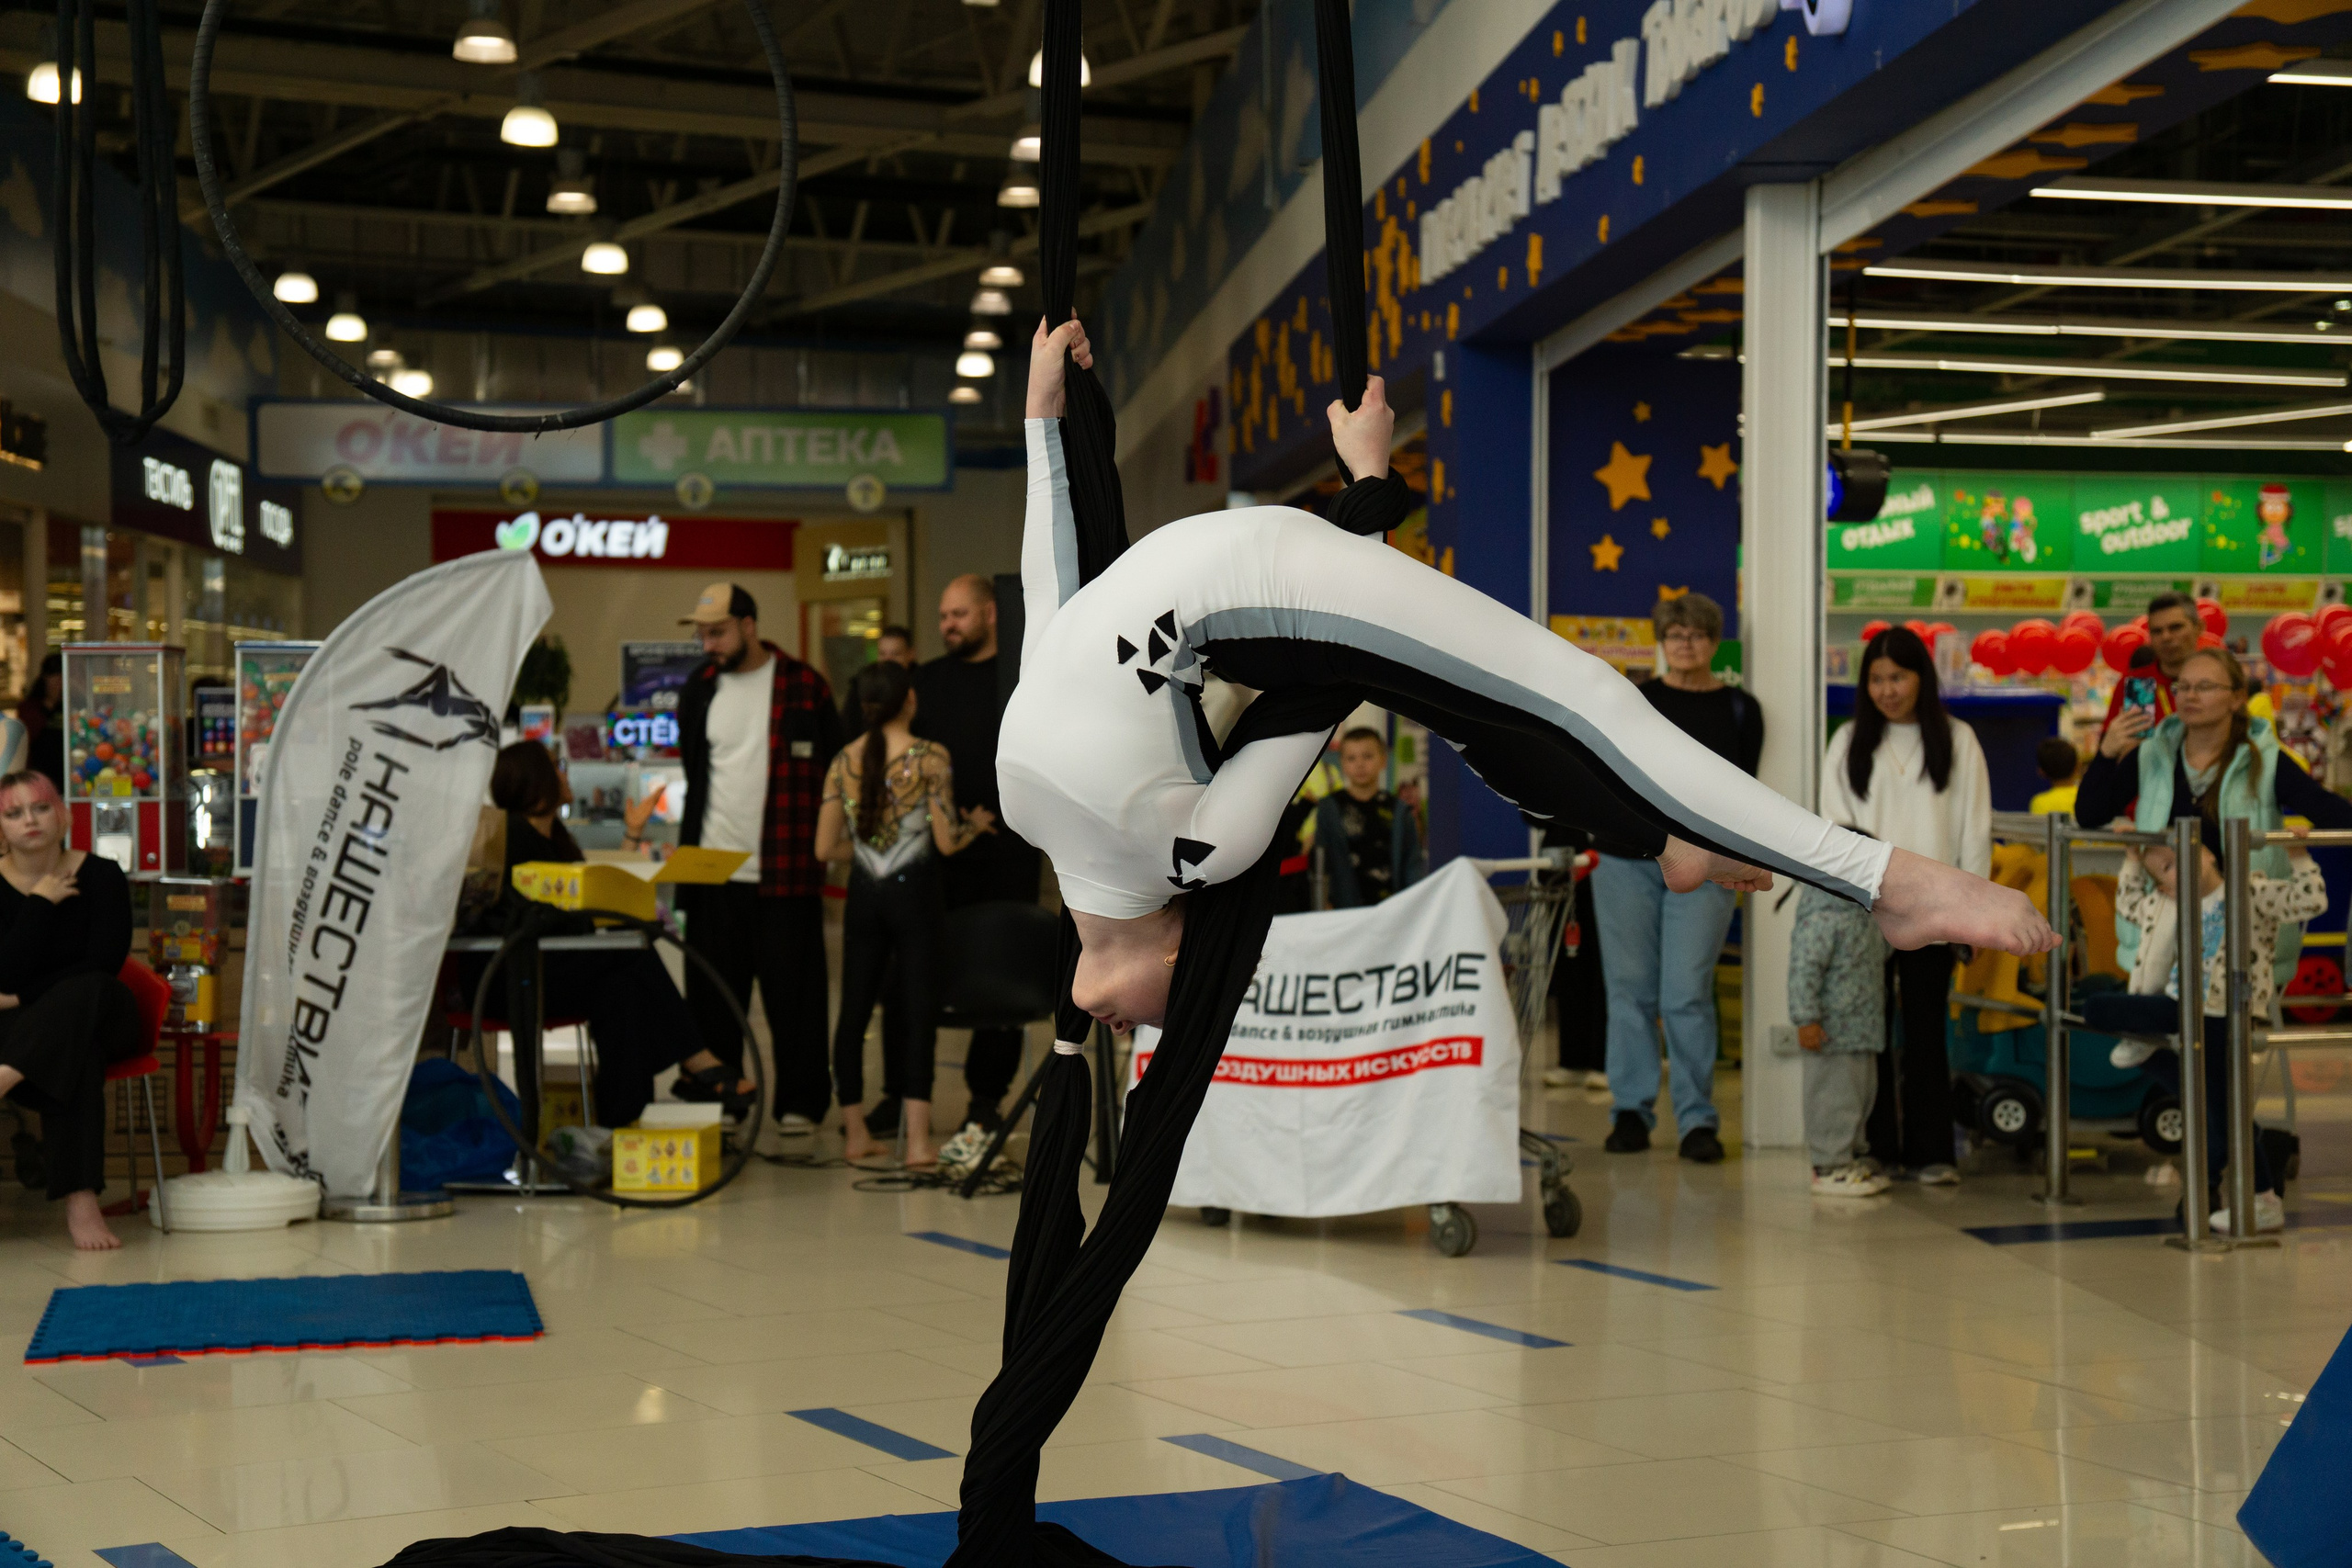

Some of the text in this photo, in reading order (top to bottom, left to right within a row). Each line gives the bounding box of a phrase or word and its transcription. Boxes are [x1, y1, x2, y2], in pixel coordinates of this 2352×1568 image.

[705, 426, 904, 466] АПТЕКА
[539, 512, 669, 558] О'КЕЙ
[2079, 495, 2170, 536] sport &
[2100, 517, 2193, 555] outdoor
[339, 737, 363, 782] pole
[317, 784, 347, 843] dance
[311, 846, 327, 862] &
[294, 751, 410, 1110] НАШЕСТВИ
[1242, 953, 1487, 1016] АШЕСТВИЕ
[1284, 1026, 1294, 1041] &
[1382, 1001, 1476, 1032] гимнастика
[1216, 1040, 1473, 1082] ОЗДУШНЫХ ИСКУССТВ
